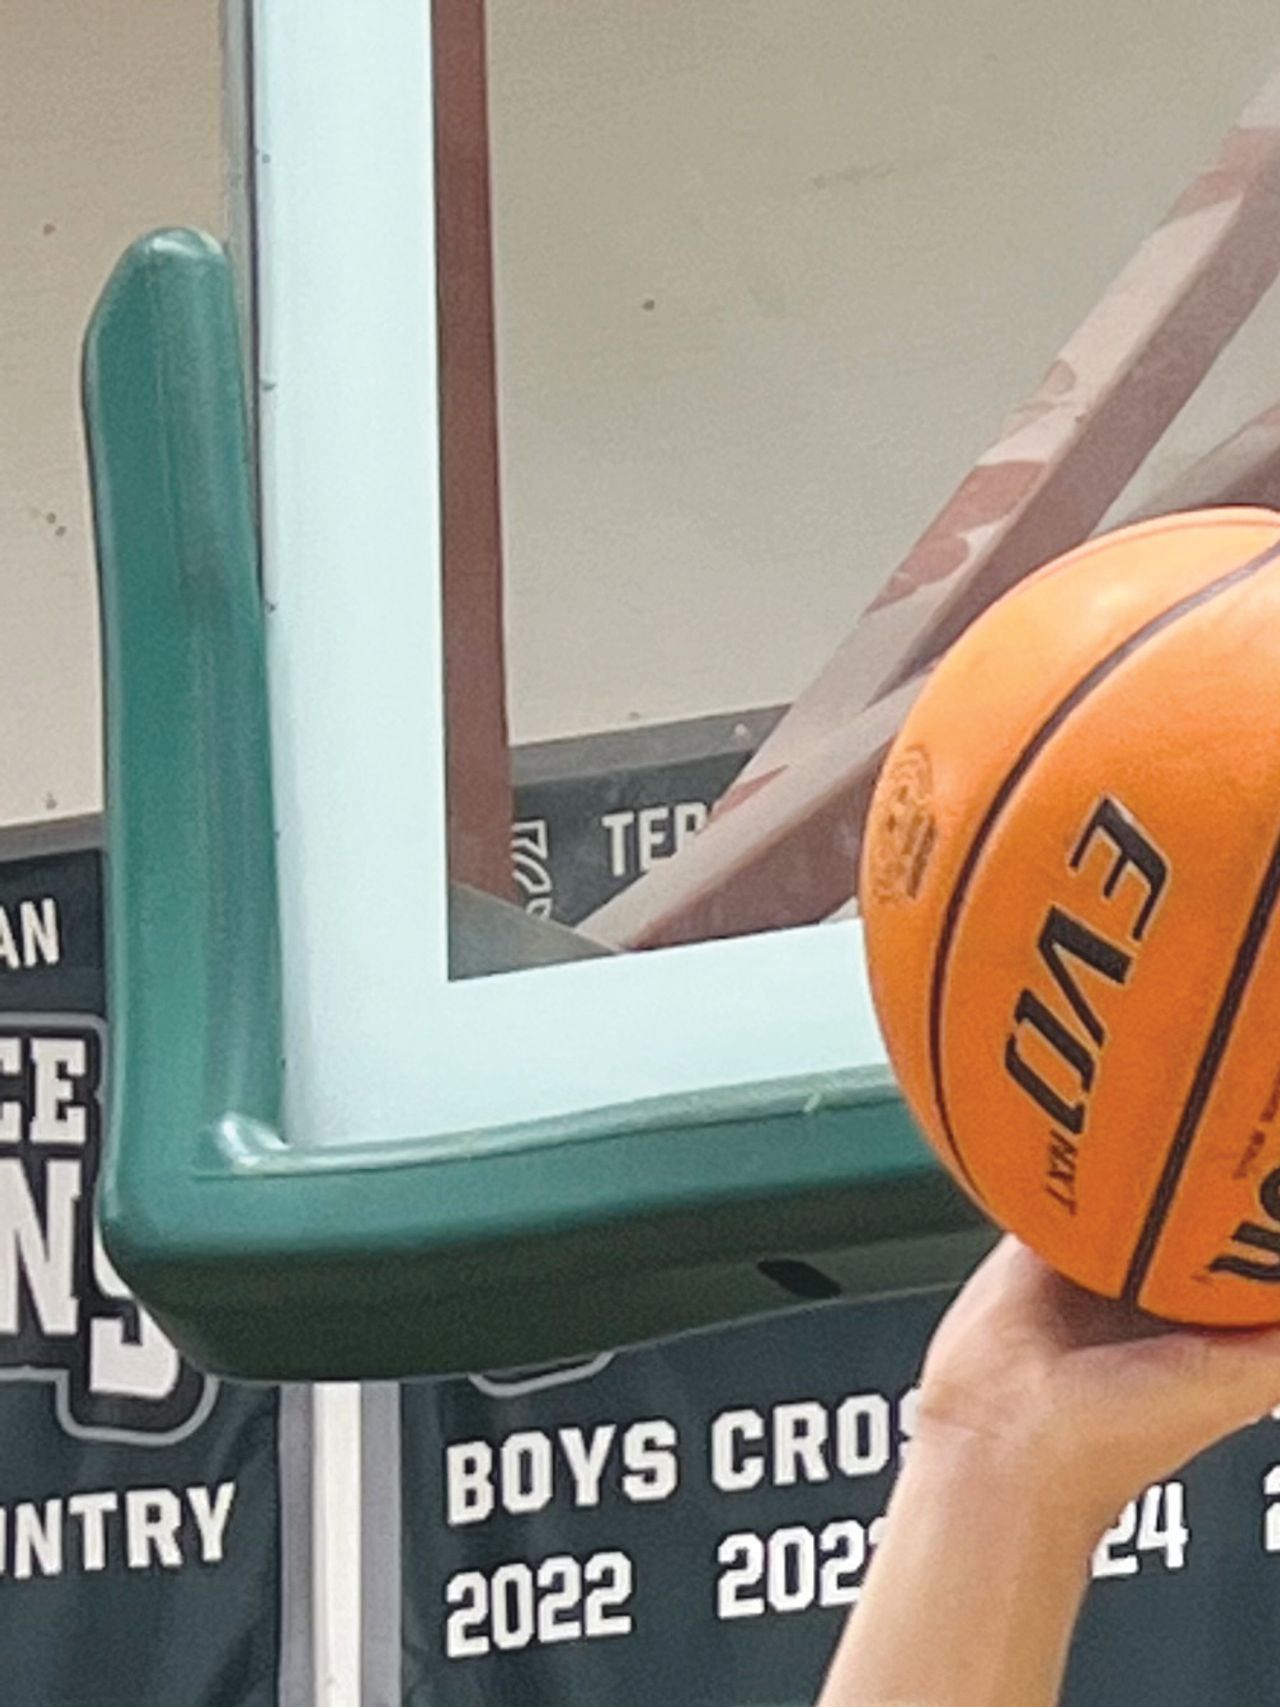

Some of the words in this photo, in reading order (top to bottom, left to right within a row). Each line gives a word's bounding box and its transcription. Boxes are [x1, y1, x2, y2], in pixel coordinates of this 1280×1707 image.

[1046, 1126, 1083, 1216] NXT
[446, 1420, 678, 1526] BOYS
[0, 1481, 235, 1579] NTRY
[446, 1551, 633, 1657] 2022
[717, 1516, 890, 1619] 202
[1091, 1482, 1189, 1579] 24
